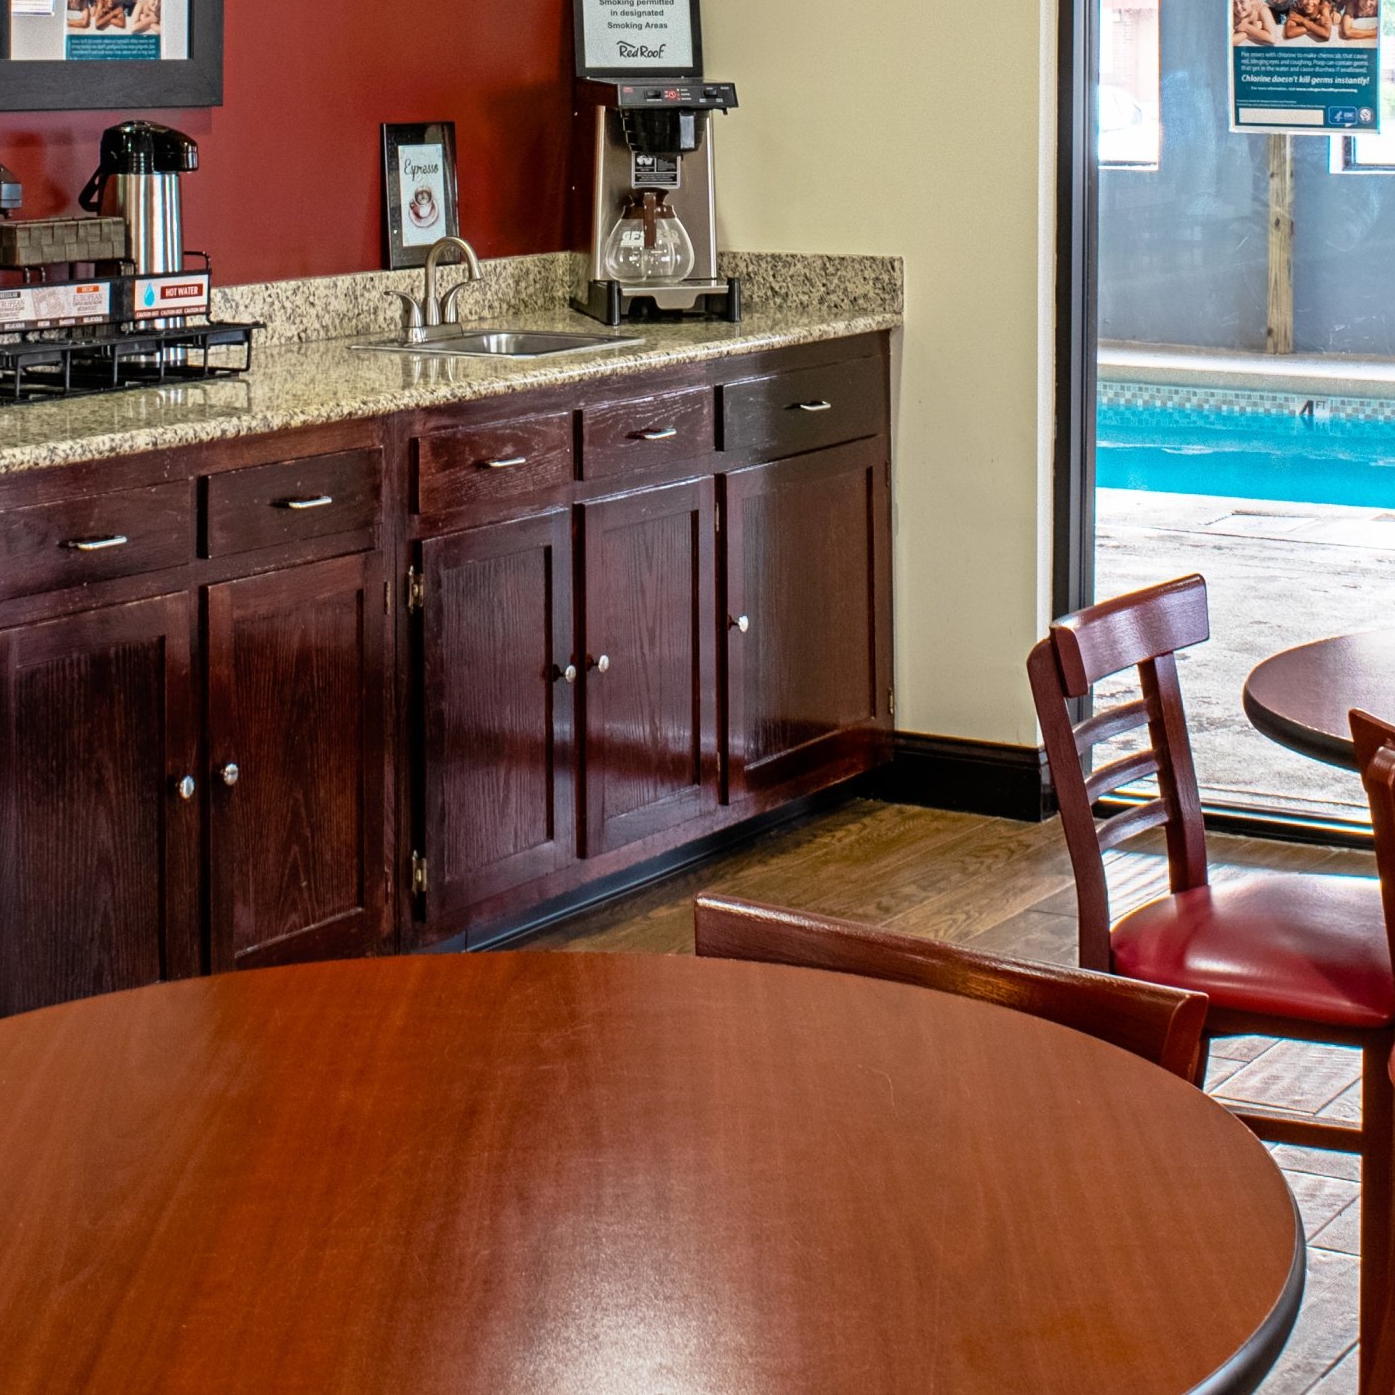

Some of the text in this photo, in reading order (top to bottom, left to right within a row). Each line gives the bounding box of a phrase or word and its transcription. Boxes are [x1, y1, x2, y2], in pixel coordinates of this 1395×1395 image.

[620, 9, 664, 18] designated
[607, 22, 643, 30] Smoking
[1241, 74, 1370, 86] Chlorine doesn't kill germs instantly!
[404, 158, 439, 182] Espresso
[165, 286, 198, 297] HOT WATER
